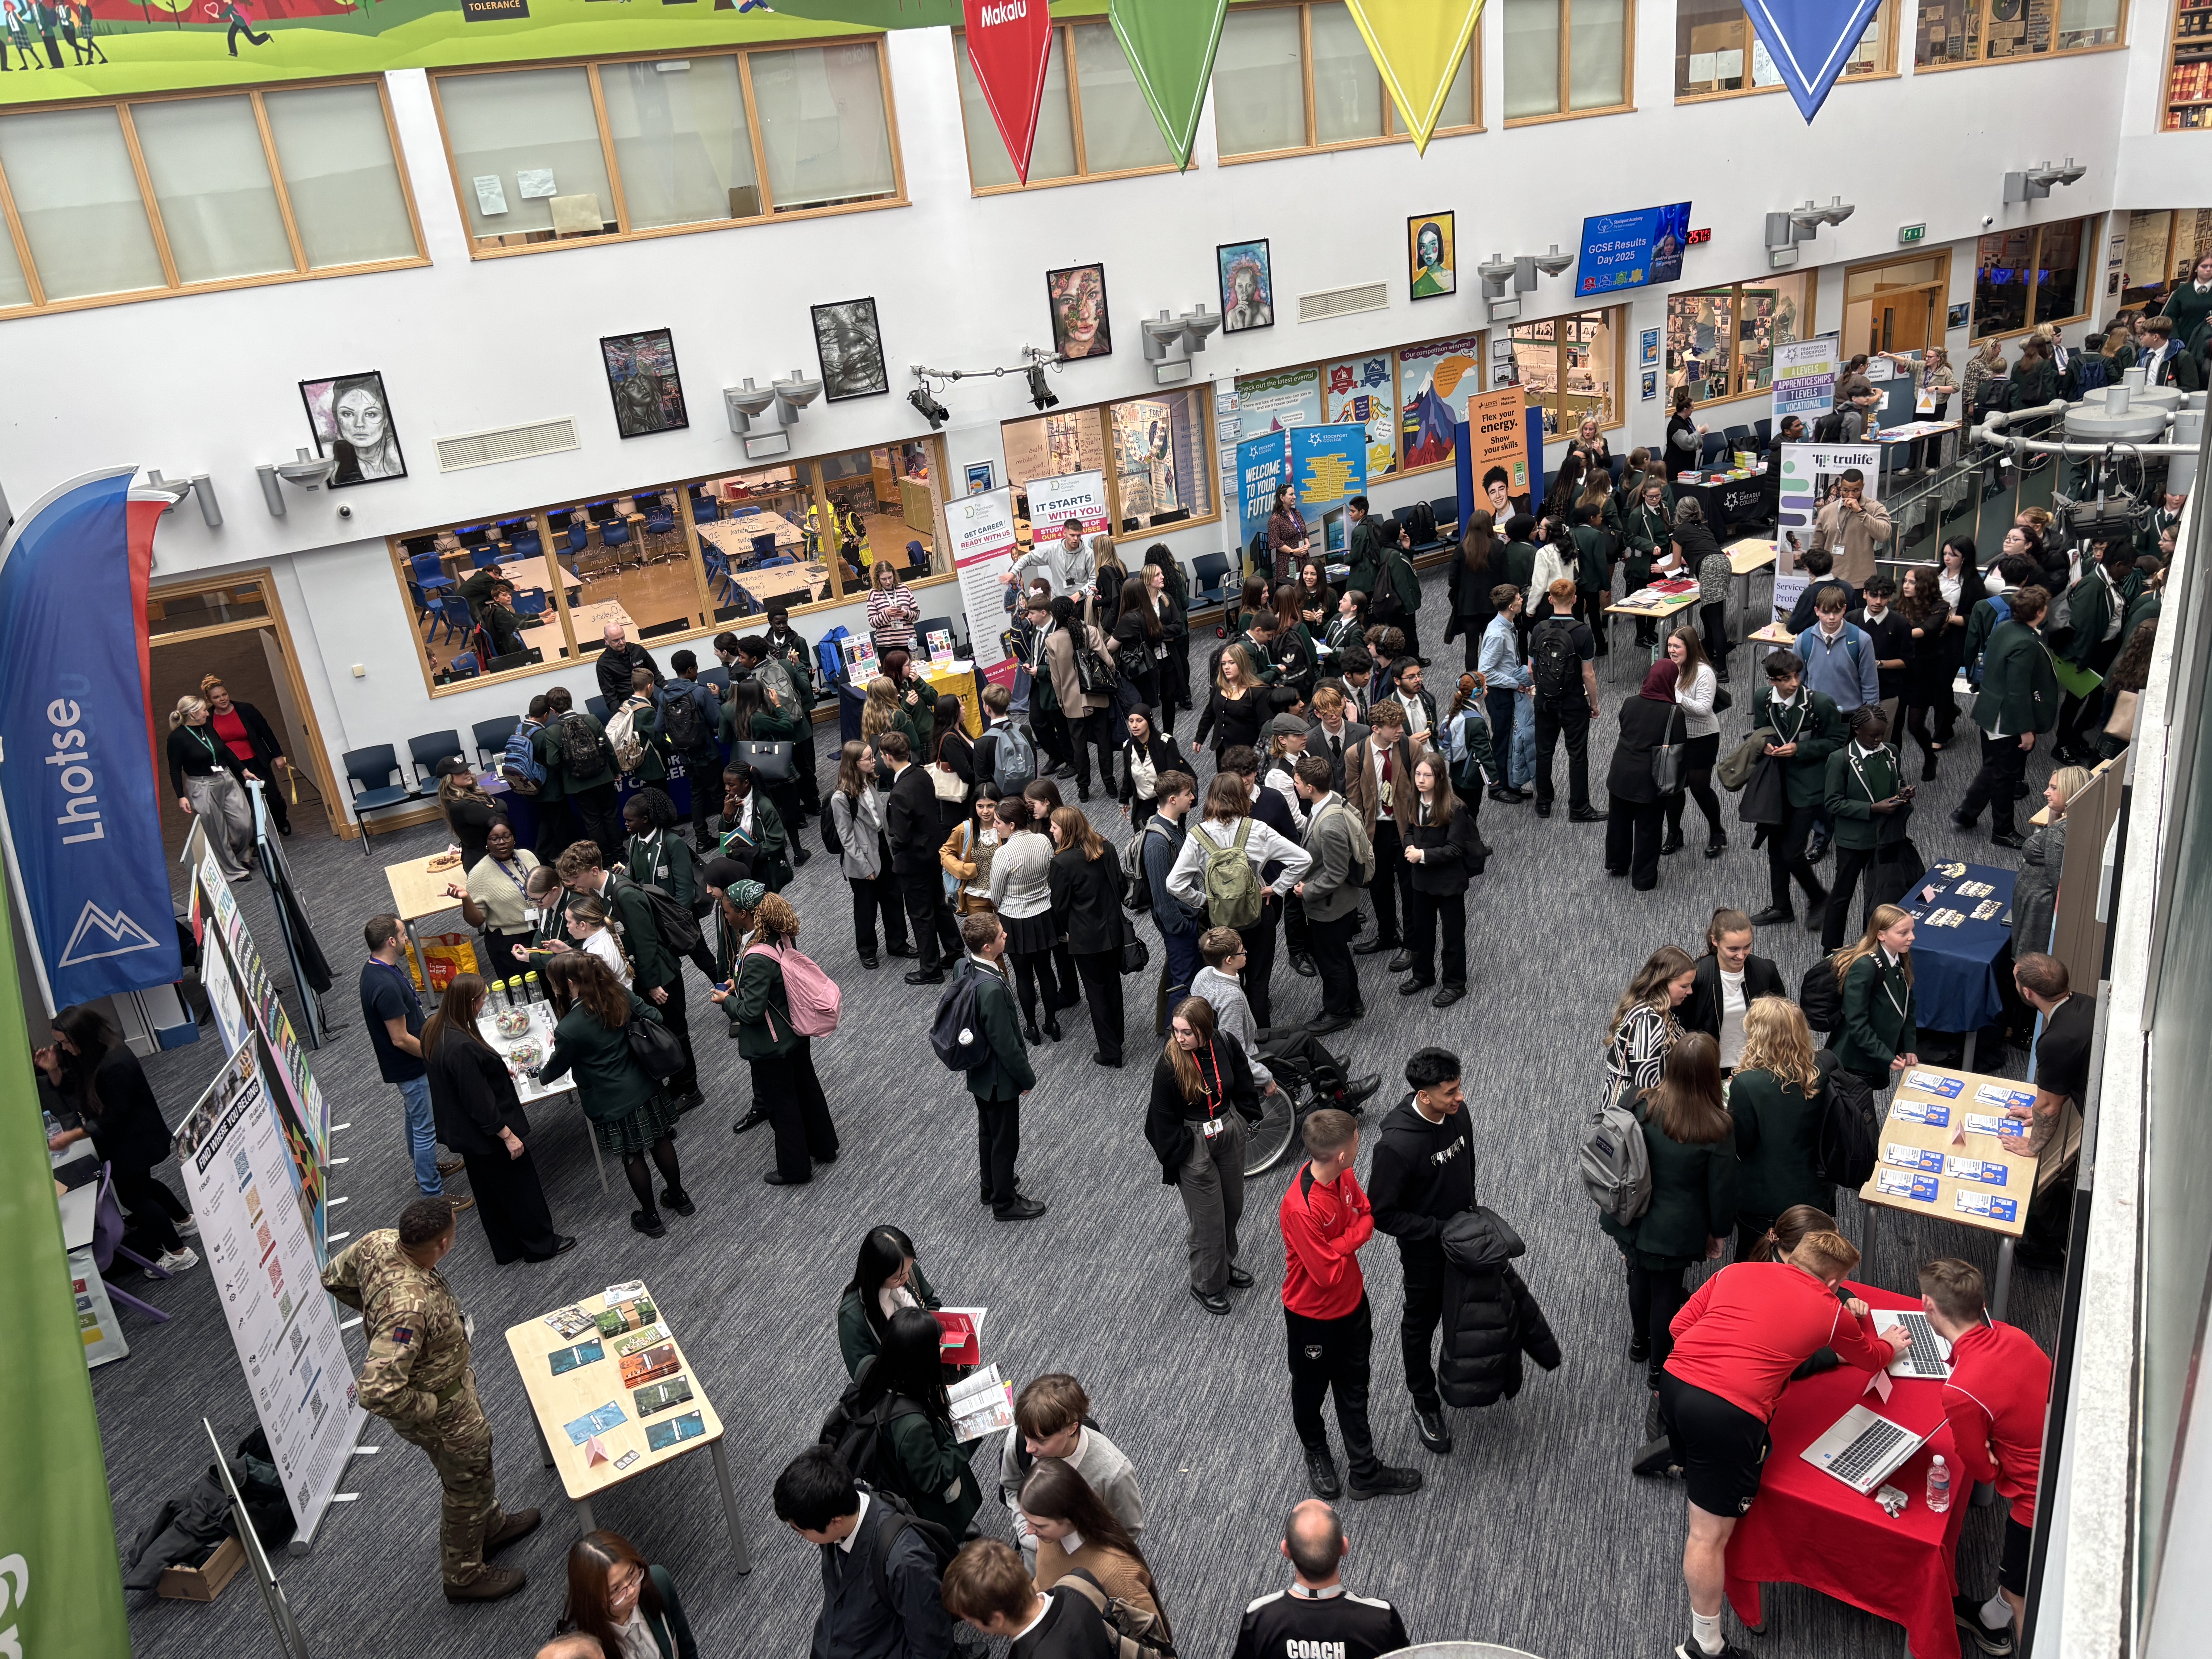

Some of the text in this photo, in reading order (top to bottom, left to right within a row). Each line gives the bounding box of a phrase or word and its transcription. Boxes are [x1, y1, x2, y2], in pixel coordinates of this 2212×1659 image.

[469, 0, 520, 11] TOLERANCE
[982, 0, 1027, 27] Makalu
[1589, 238, 1646, 254] GCSE Results
[1597, 251, 1635, 265] Day 2025
[1416, 345, 1448, 357] competition
[1449, 341, 1470, 350] winners!
[1791, 364, 1819, 376] A LEVELS
[1237, 384, 1255, 393] Check
[1294, 372, 1314, 381] events!
[1778, 374, 1831, 390] APPRENTICESHIPS
[1791, 388, 1818, 400] T LEVELS
[1786, 399, 1822, 412] VOCATIONAL
[1482, 410, 1515, 422] Flex your
[1480, 419, 1518, 434] energy.
[1259, 442, 1275, 451] STOCKPORT
[1491, 435, 1510, 444] Show
[1484, 440, 1518, 456] your skills
[1834, 454, 1873, 465] trulife
[1246, 459, 1281, 483] WELCOME
[1246, 477, 1277, 499] TO YOUR
[1036, 494, 1092, 513] IT STARTS
[1739, 491, 1761, 501] CHEADLE
[1739, 497, 1759, 506] COLLEGE
[1048, 505, 1101, 520] WITH YOU
[964, 521, 1003, 539] GET CAREER
[1041, 526, 1063, 535] STUDY
[961, 538, 982, 549] READY
[983, 532, 1001, 542] WITH
[1777, 582, 1807, 591] Services
[1776, 594, 1798, 603] Prote
[45, 698, 105, 845] Lhotse
[198, 1148, 212, 1170] FIND
[210, 1126, 228, 1152] WHERE
[226, 1108, 239, 1128] YOU
[237, 1082, 259, 1111] BELONG
[1286, 1639, 1345, 1659] COACH
